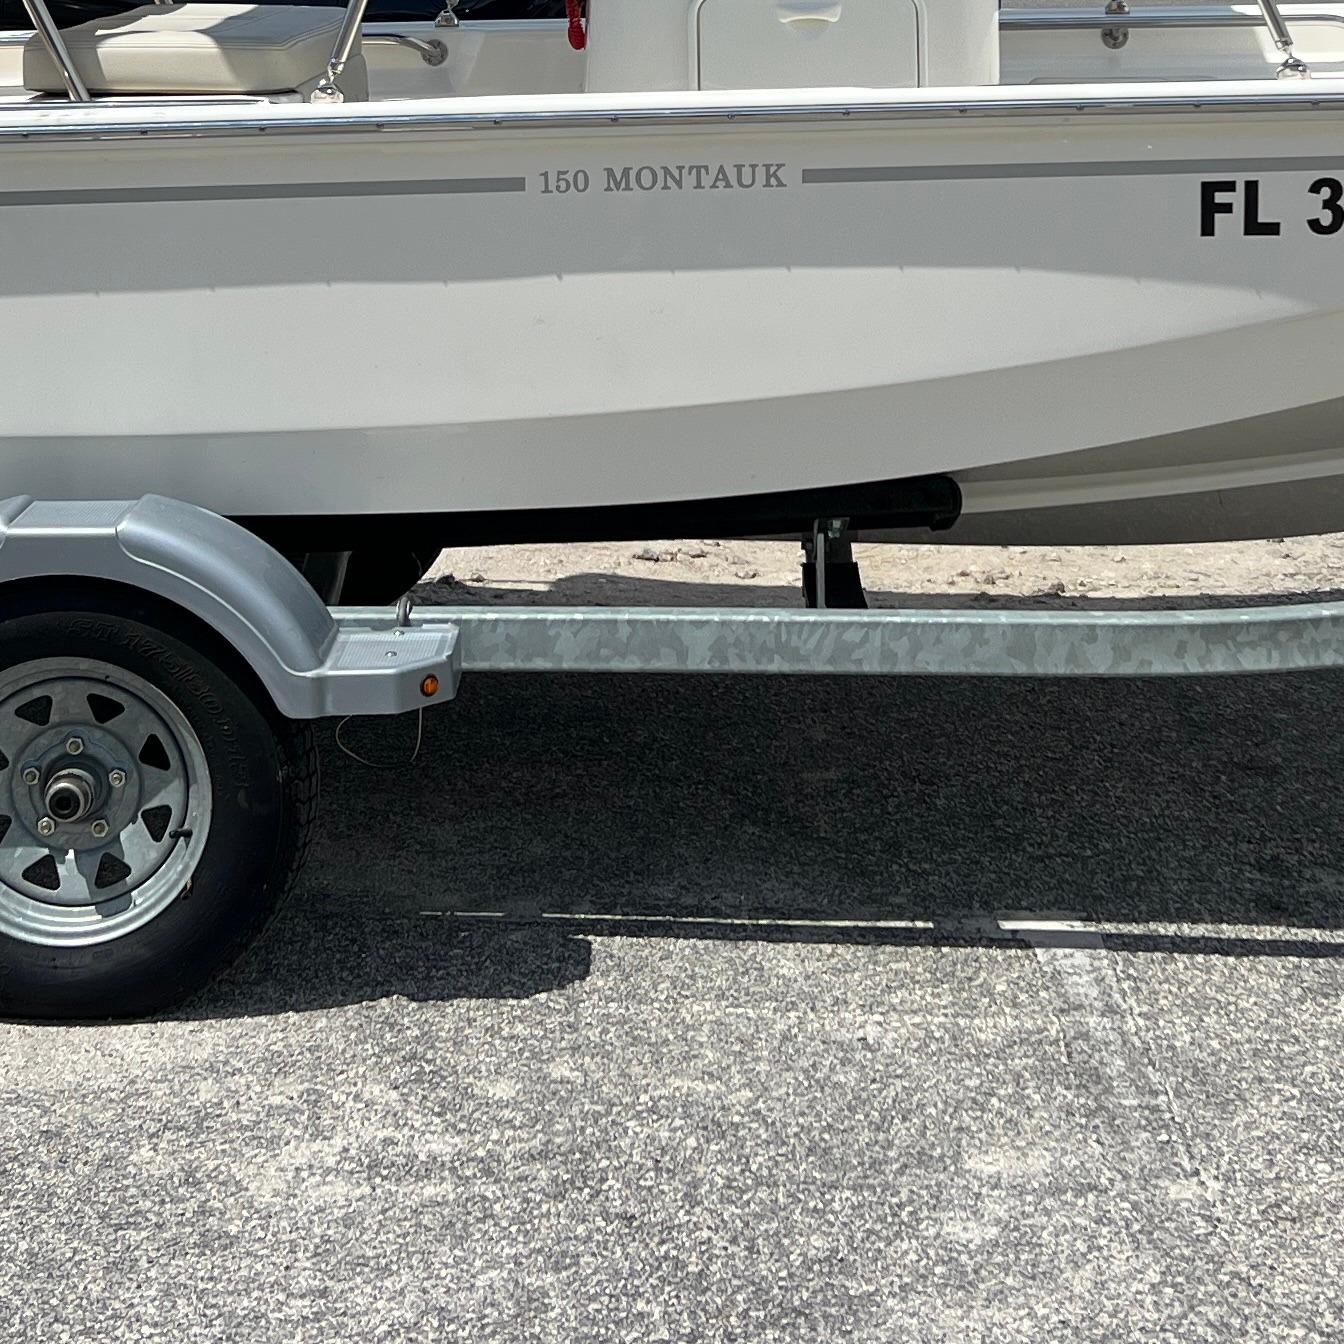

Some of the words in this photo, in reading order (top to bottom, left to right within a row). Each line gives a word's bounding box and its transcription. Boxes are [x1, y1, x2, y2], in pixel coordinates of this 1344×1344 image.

[539, 169, 590, 194] 150
[603, 163, 787, 192] MONTAUK
[1199, 179, 1281, 238] FL
